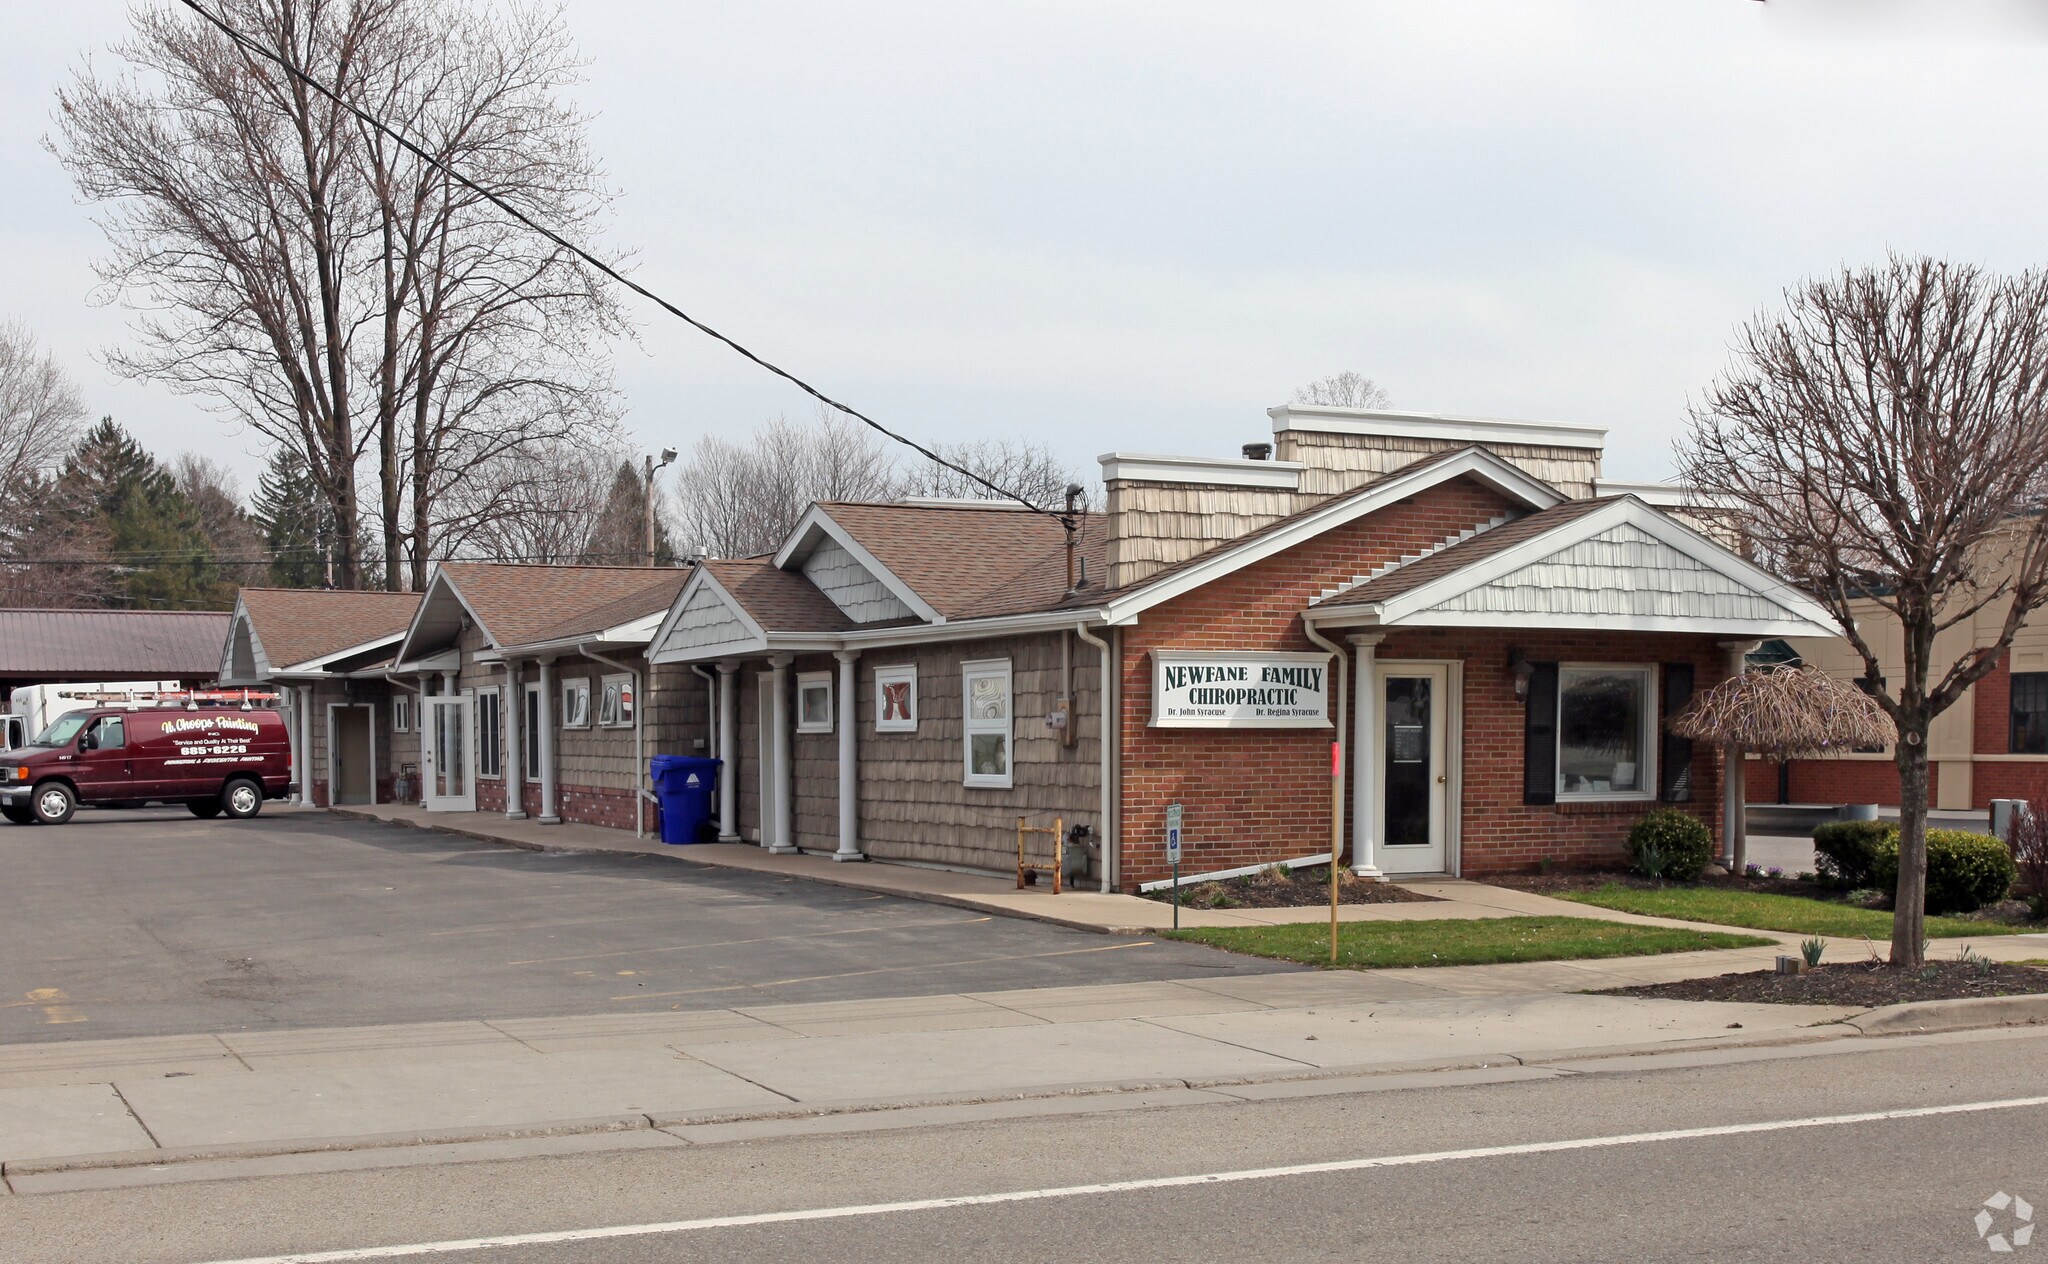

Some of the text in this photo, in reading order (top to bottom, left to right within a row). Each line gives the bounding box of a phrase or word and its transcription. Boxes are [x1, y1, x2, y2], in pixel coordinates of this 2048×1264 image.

[1165, 666, 1322, 693] NEWFANE FAMILY
[1189, 688, 1298, 705] CHIROPRACTIC
[1168, 708, 1226, 717] Dr. John Syracuse
[1256, 708, 1320, 717] Dr. Regina Syracuse
[215, 716, 259, 735] Painting
